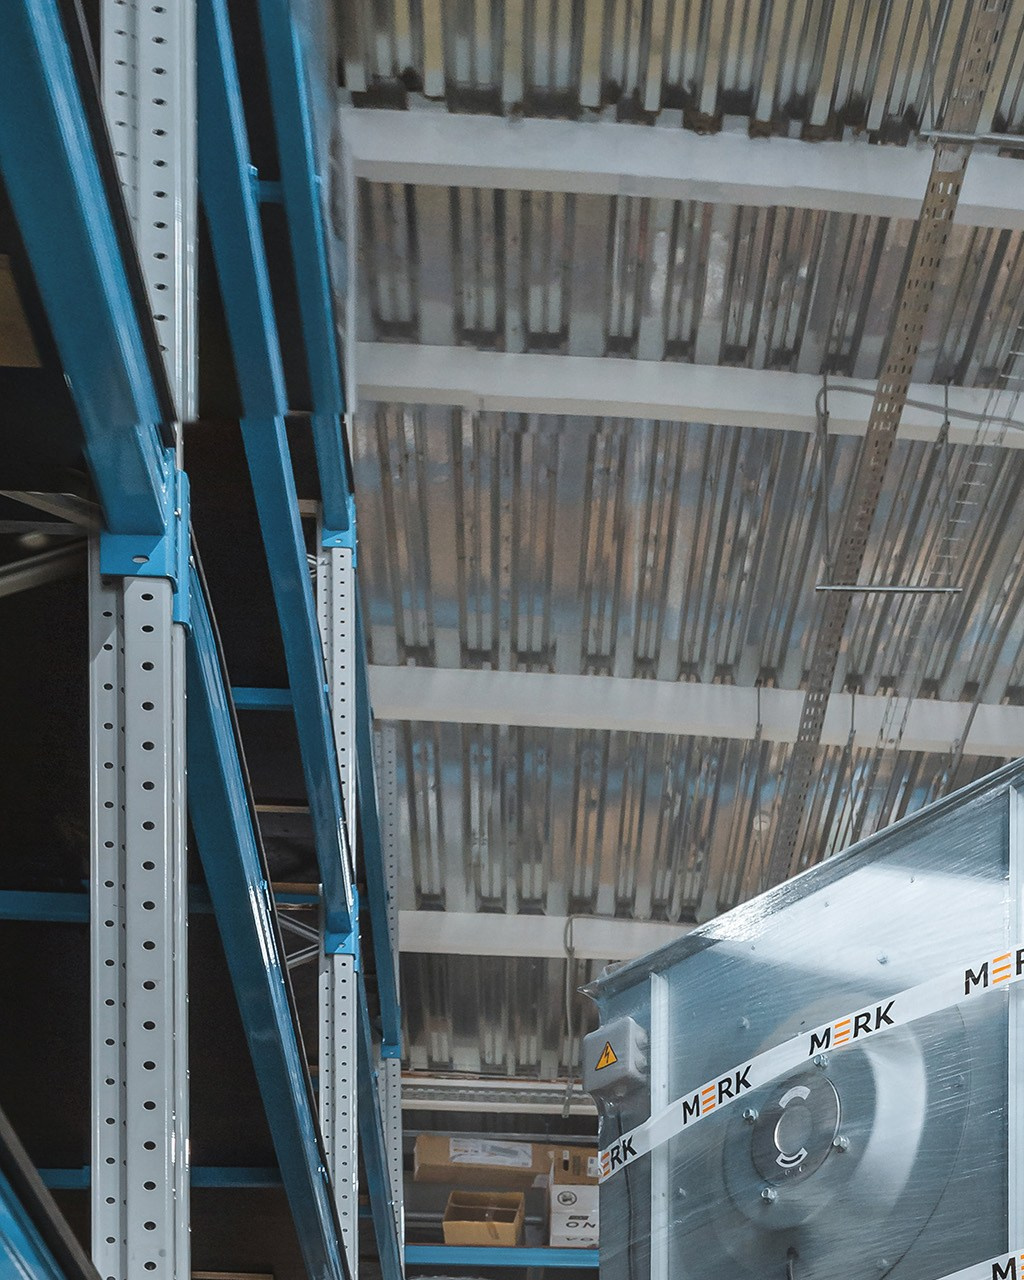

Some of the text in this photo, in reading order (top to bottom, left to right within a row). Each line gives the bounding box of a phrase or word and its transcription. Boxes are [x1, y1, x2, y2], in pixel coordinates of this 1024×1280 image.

[600, 1134, 638, 1177] ERK
[682, 1064, 752, 1125] MERK
[809, 1000, 895, 1056] MERK
